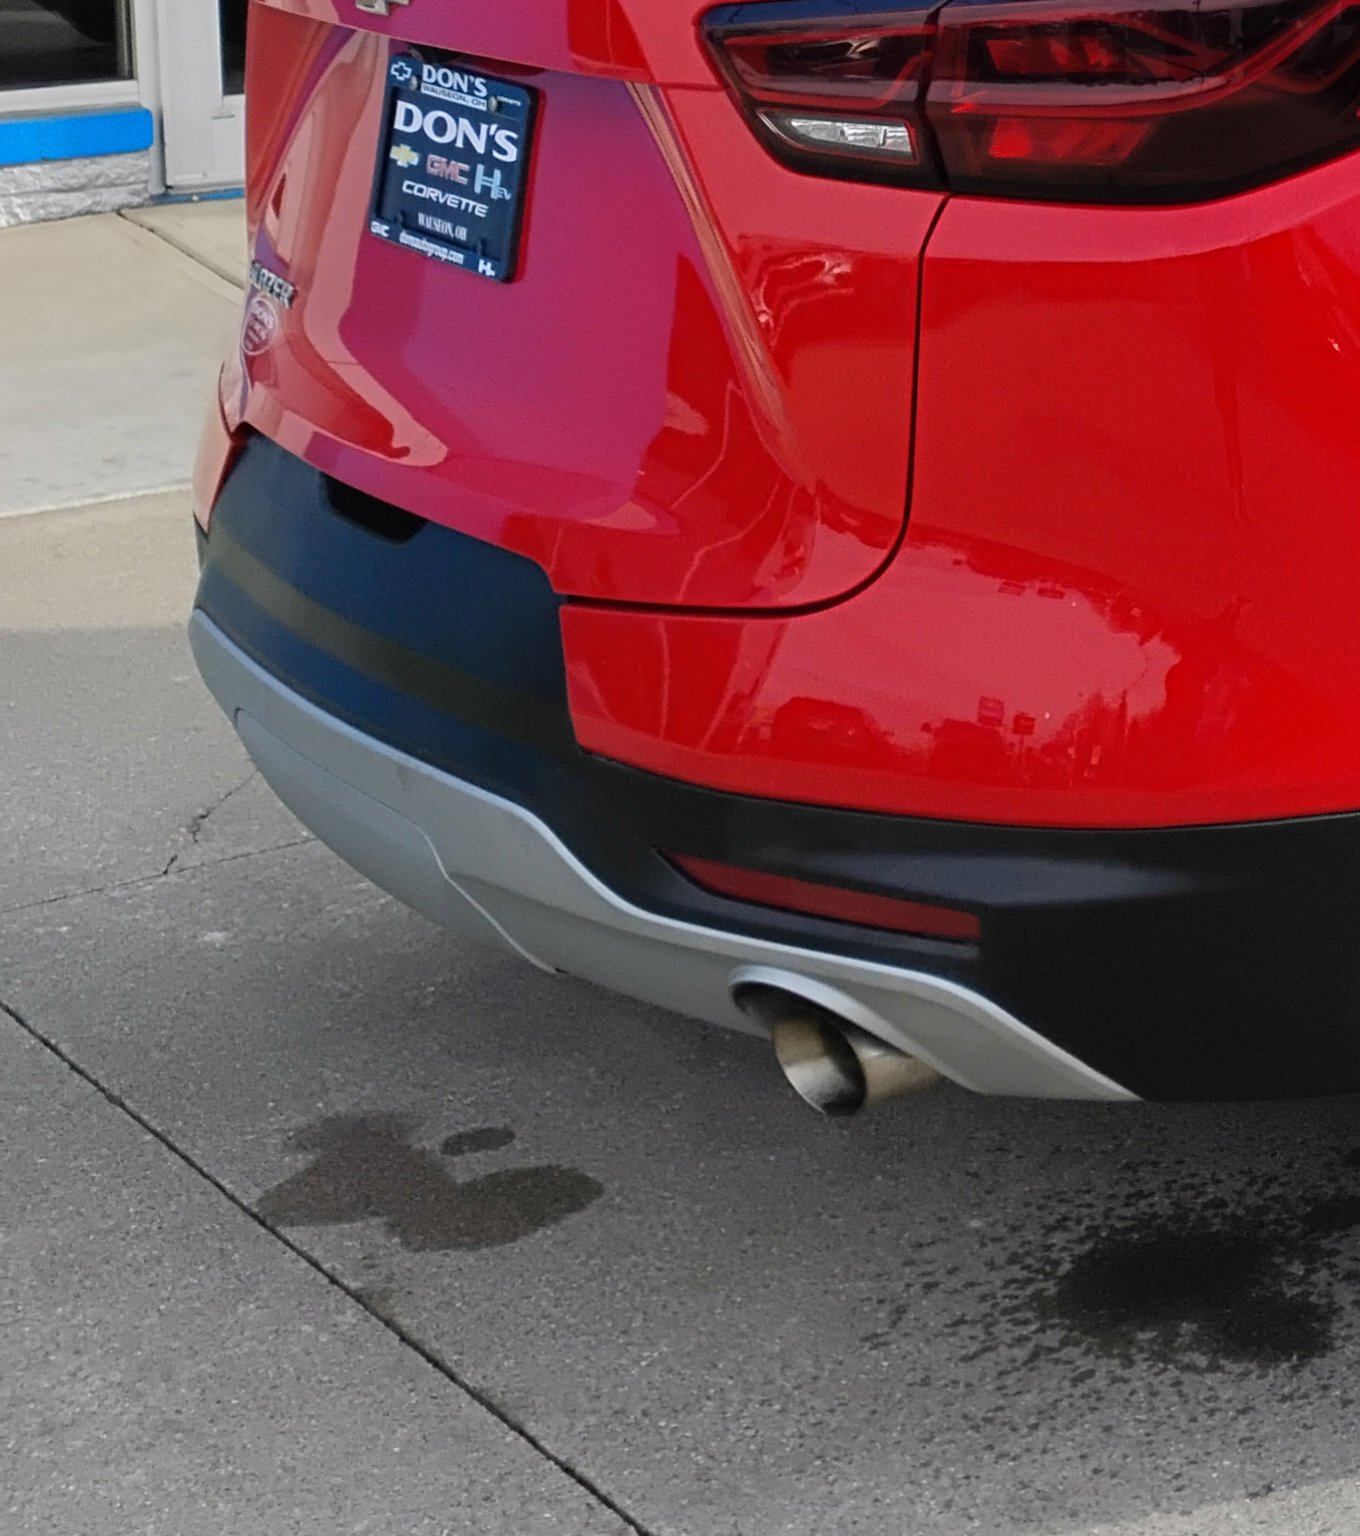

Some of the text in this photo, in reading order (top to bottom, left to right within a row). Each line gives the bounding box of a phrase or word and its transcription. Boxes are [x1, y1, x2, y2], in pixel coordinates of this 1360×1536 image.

[422, 64, 488, 97] DON'S
[393, 99, 518, 162] DON'S
[426, 154, 470, 185] GMC
[402, 180, 489, 217] CORVETTE
